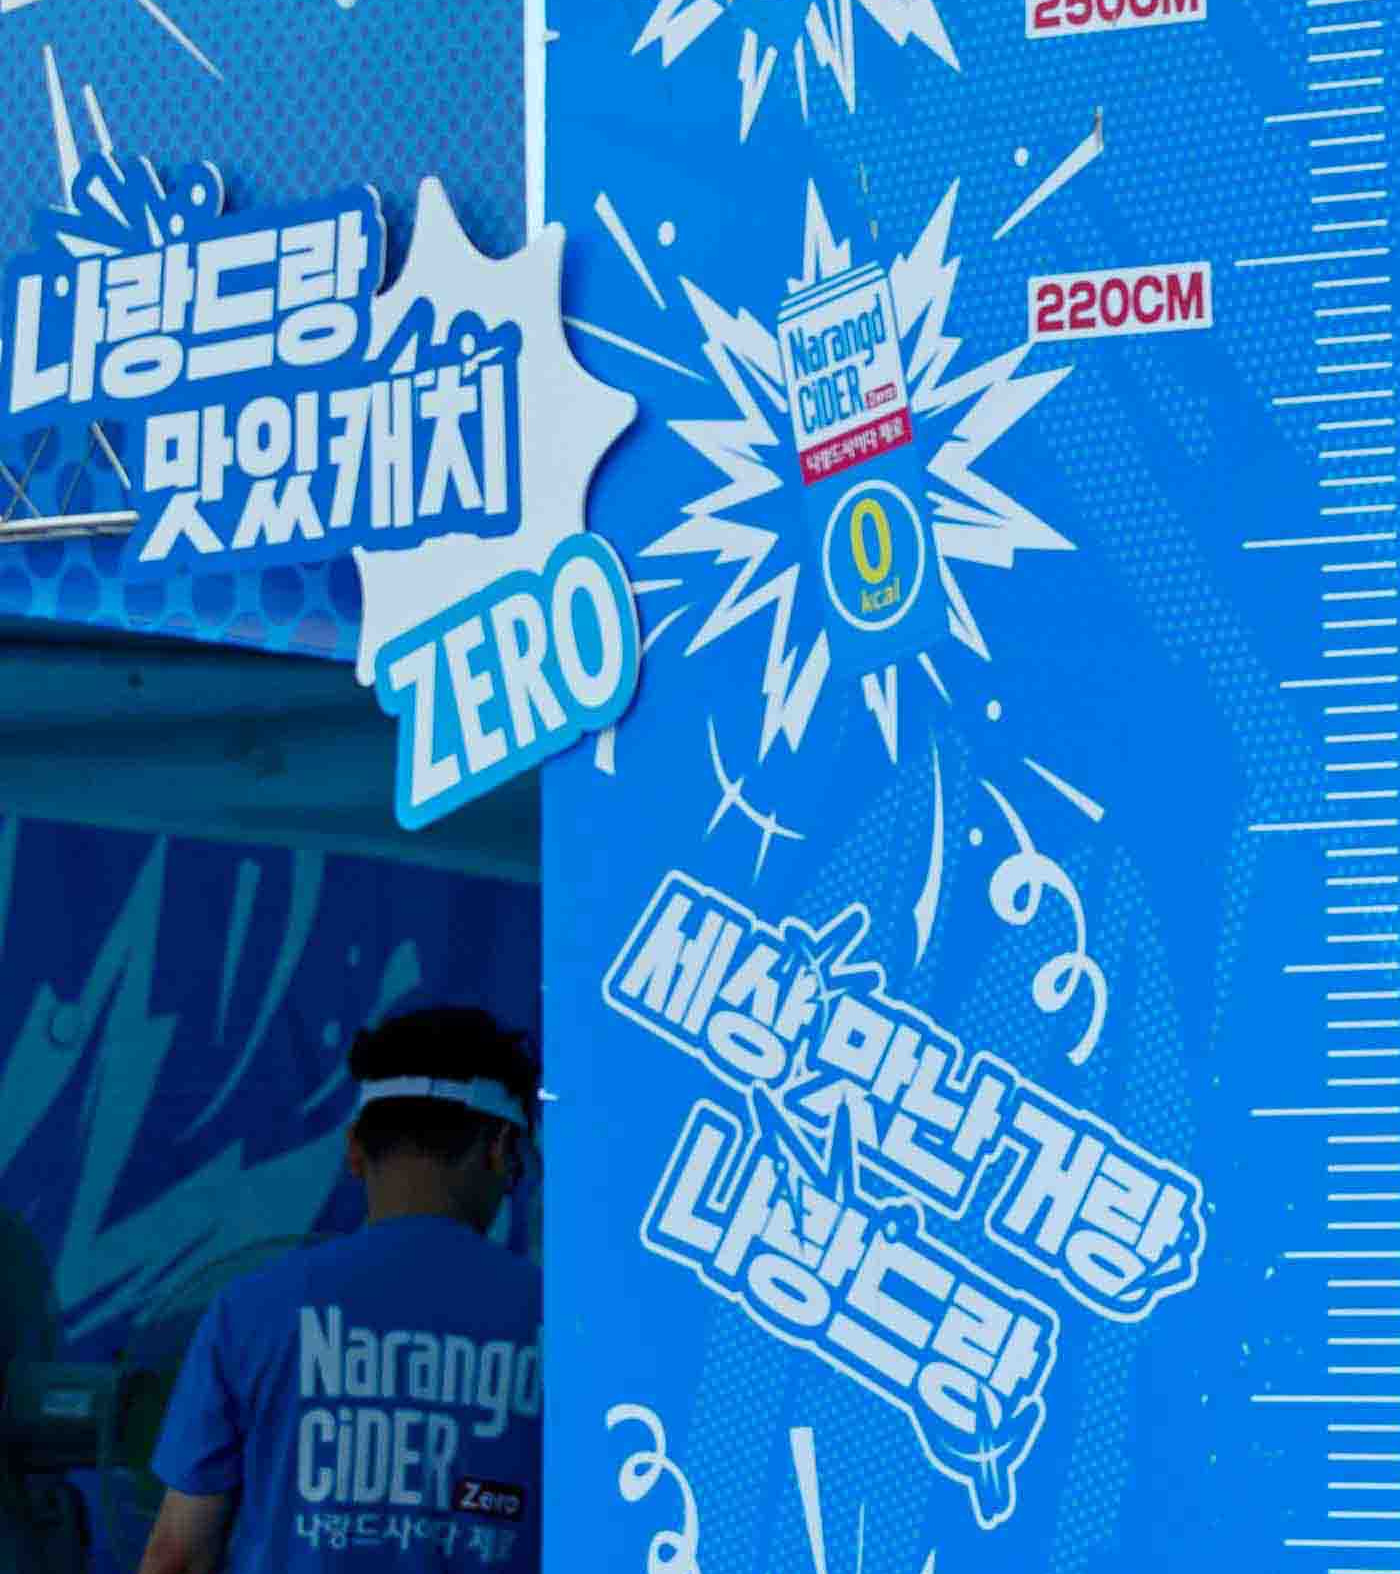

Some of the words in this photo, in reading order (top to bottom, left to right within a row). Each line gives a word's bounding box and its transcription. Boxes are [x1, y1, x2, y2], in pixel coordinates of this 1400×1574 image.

[9, 211, 368, 414] 나랑드랑
[1036, 271, 1204, 332] 220CM
[850, 498, 892, 584] 0
[389, 555, 623, 808] ZERO
